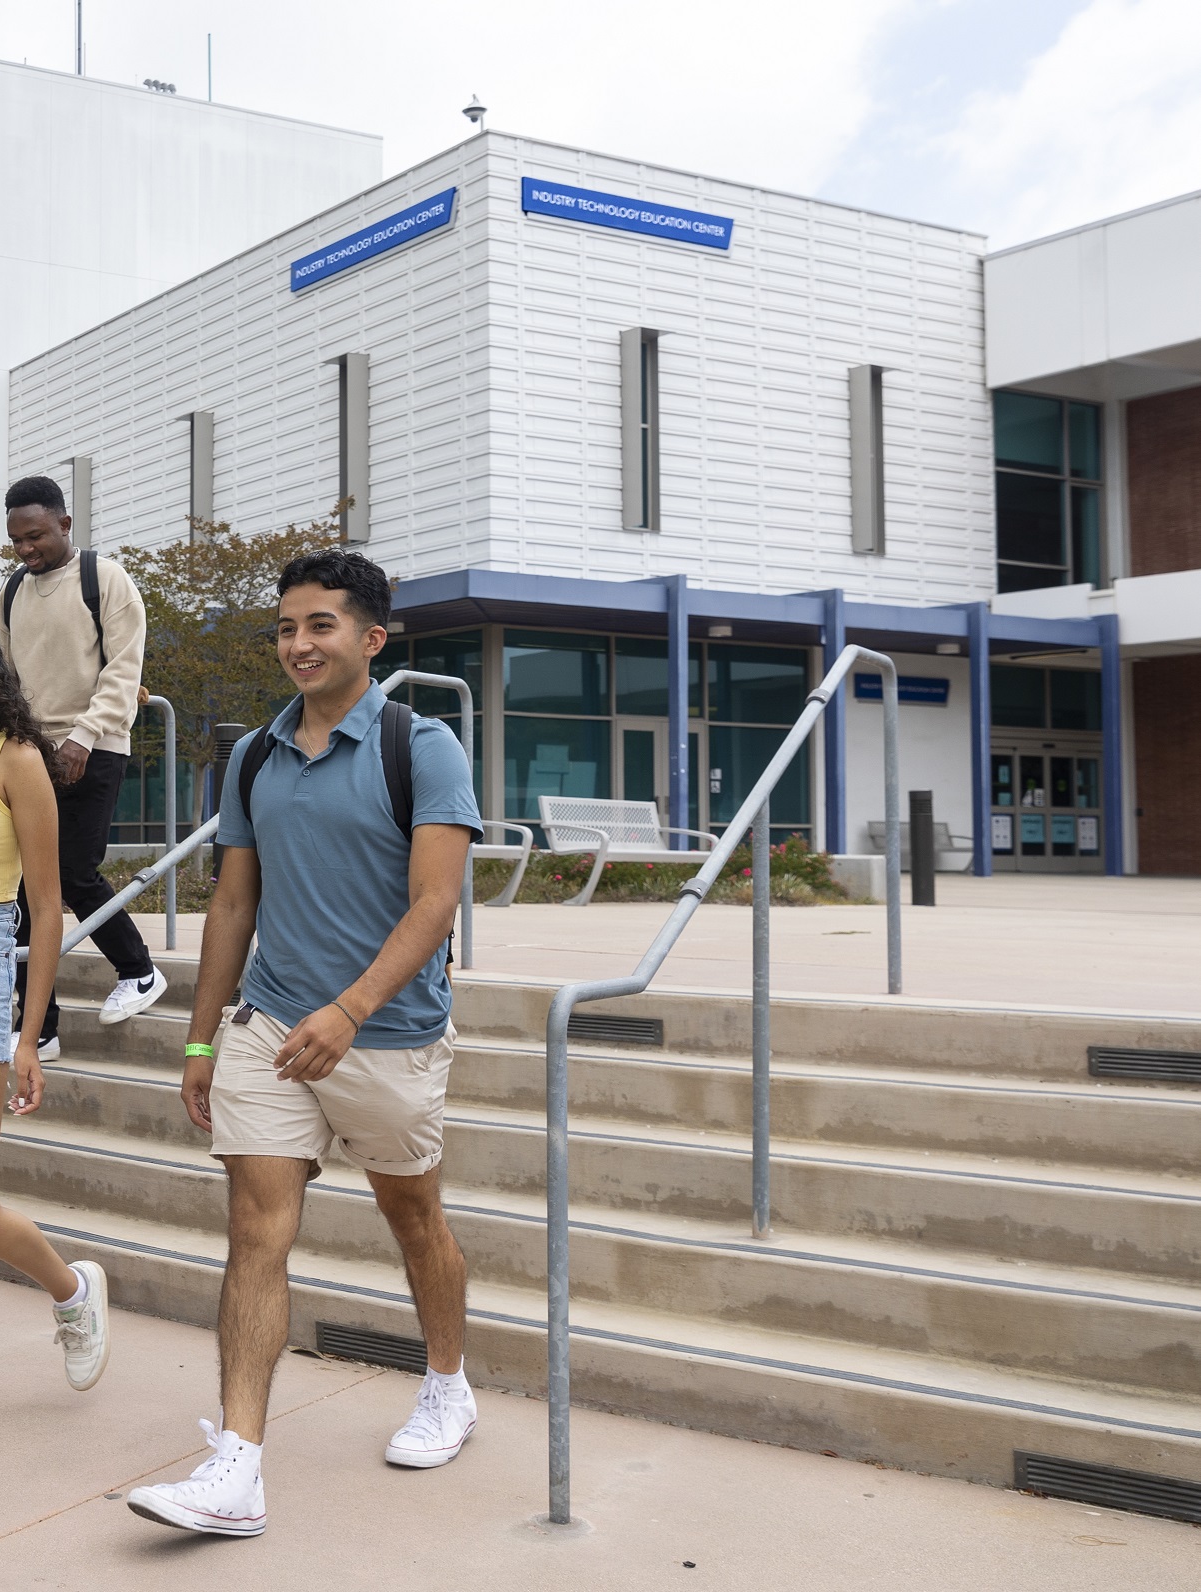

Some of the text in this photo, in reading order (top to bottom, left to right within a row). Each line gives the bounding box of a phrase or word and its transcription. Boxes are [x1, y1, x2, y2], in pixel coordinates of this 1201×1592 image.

[296, 203, 445, 279] INDUSTRY TECHNOLOGY EDUCATION CENTER
[532, 190, 725, 237] INDUSTRY TECHNOLOGY EDUCATION CENTER
